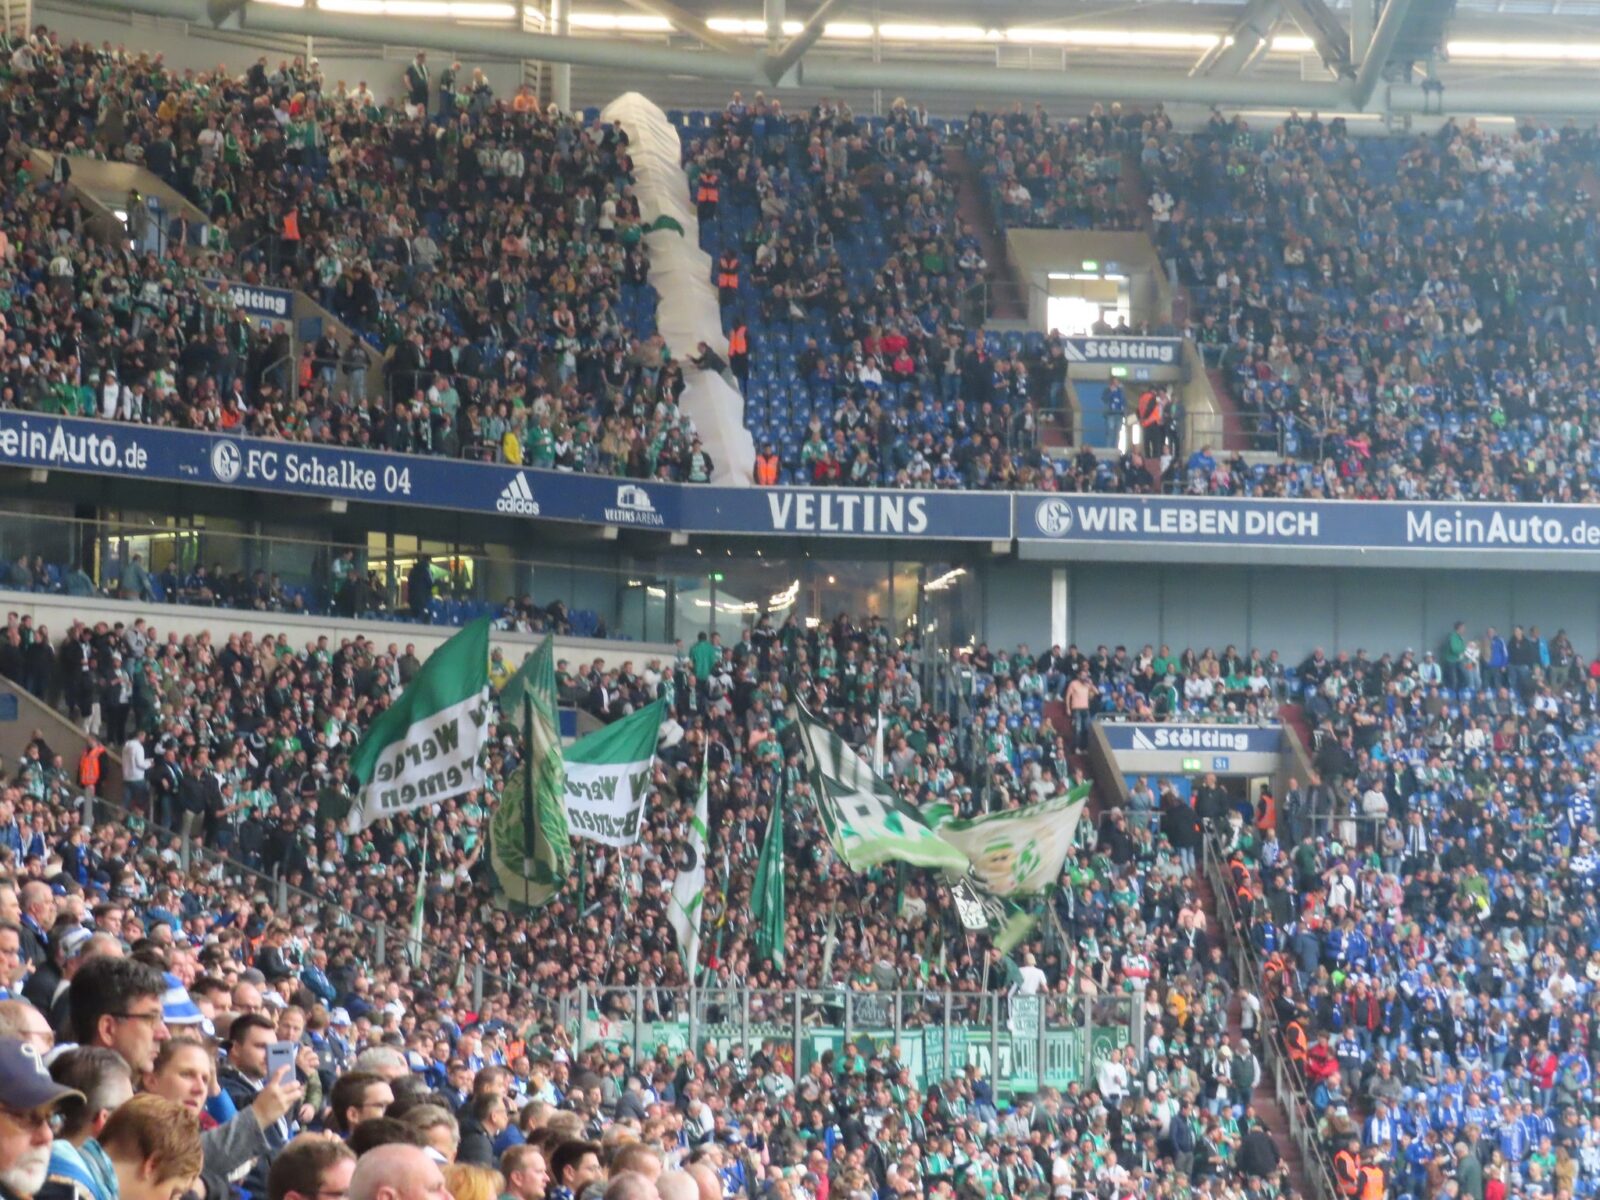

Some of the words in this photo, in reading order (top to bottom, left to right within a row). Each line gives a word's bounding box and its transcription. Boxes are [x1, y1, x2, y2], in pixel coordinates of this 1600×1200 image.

[1084, 340, 1173, 363] Stölting
[0, 419, 149, 471] einAuto.de
[246, 449, 278, 482] FC
[284, 454, 376, 492] Schalke
[383, 465, 412, 496] 04
[496, 497, 540, 516] adidas
[604, 507, 635, 523] VELTINS
[635, 512, 664, 526] ARENA
[767, 493, 928, 534] VELTINS
[1077, 505, 1138, 533] WIR
[1143, 507, 1239, 536] LEBEN
[1245, 509, 1320, 537] DICH
[1406, 509, 1600, 545] MeinAuto.de
[1154, 727, 1249, 752] Stölting
